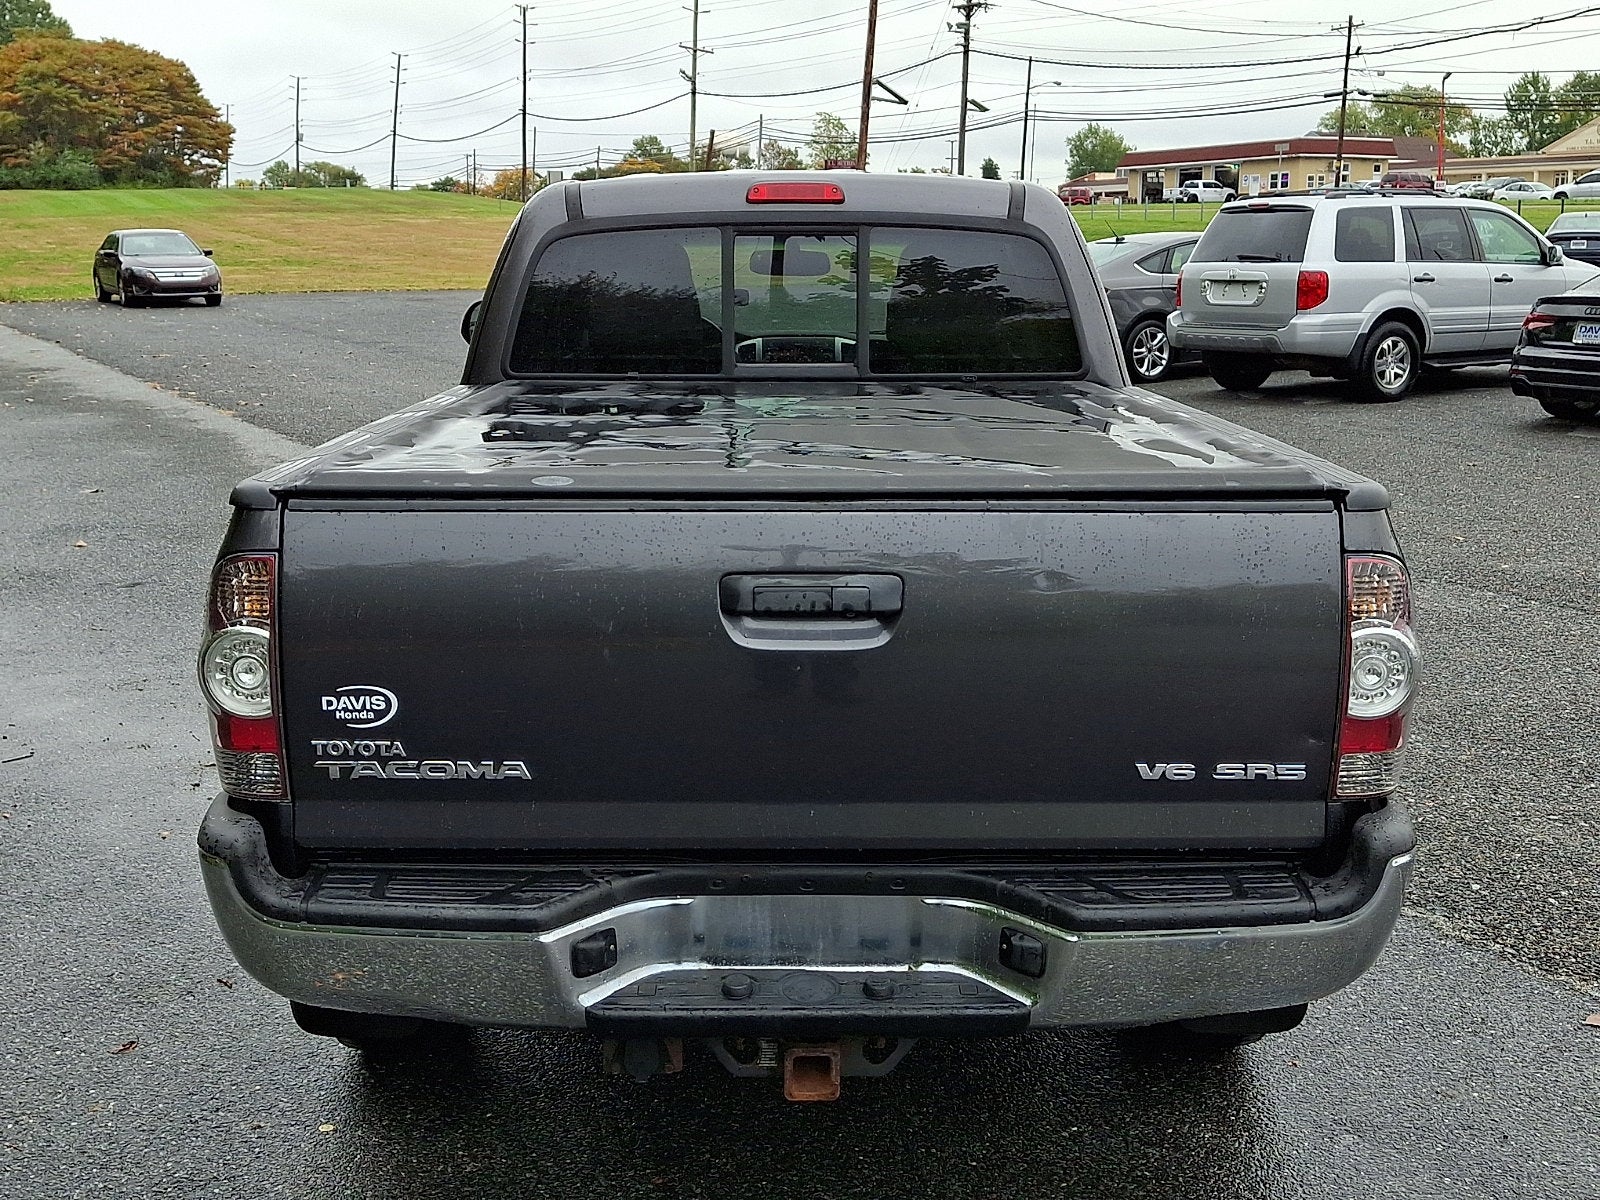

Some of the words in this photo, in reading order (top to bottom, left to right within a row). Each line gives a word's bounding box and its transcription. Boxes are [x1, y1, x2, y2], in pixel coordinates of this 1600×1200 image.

[321, 695, 386, 711] DAVIS
[335, 710, 375, 720] Honda
[311, 740, 407, 757] TOYOTA
[313, 760, 532, 780] TACOMA
[1135, 763, 1196, 780] V6
[1212, 763, 1307, 780] SR5
